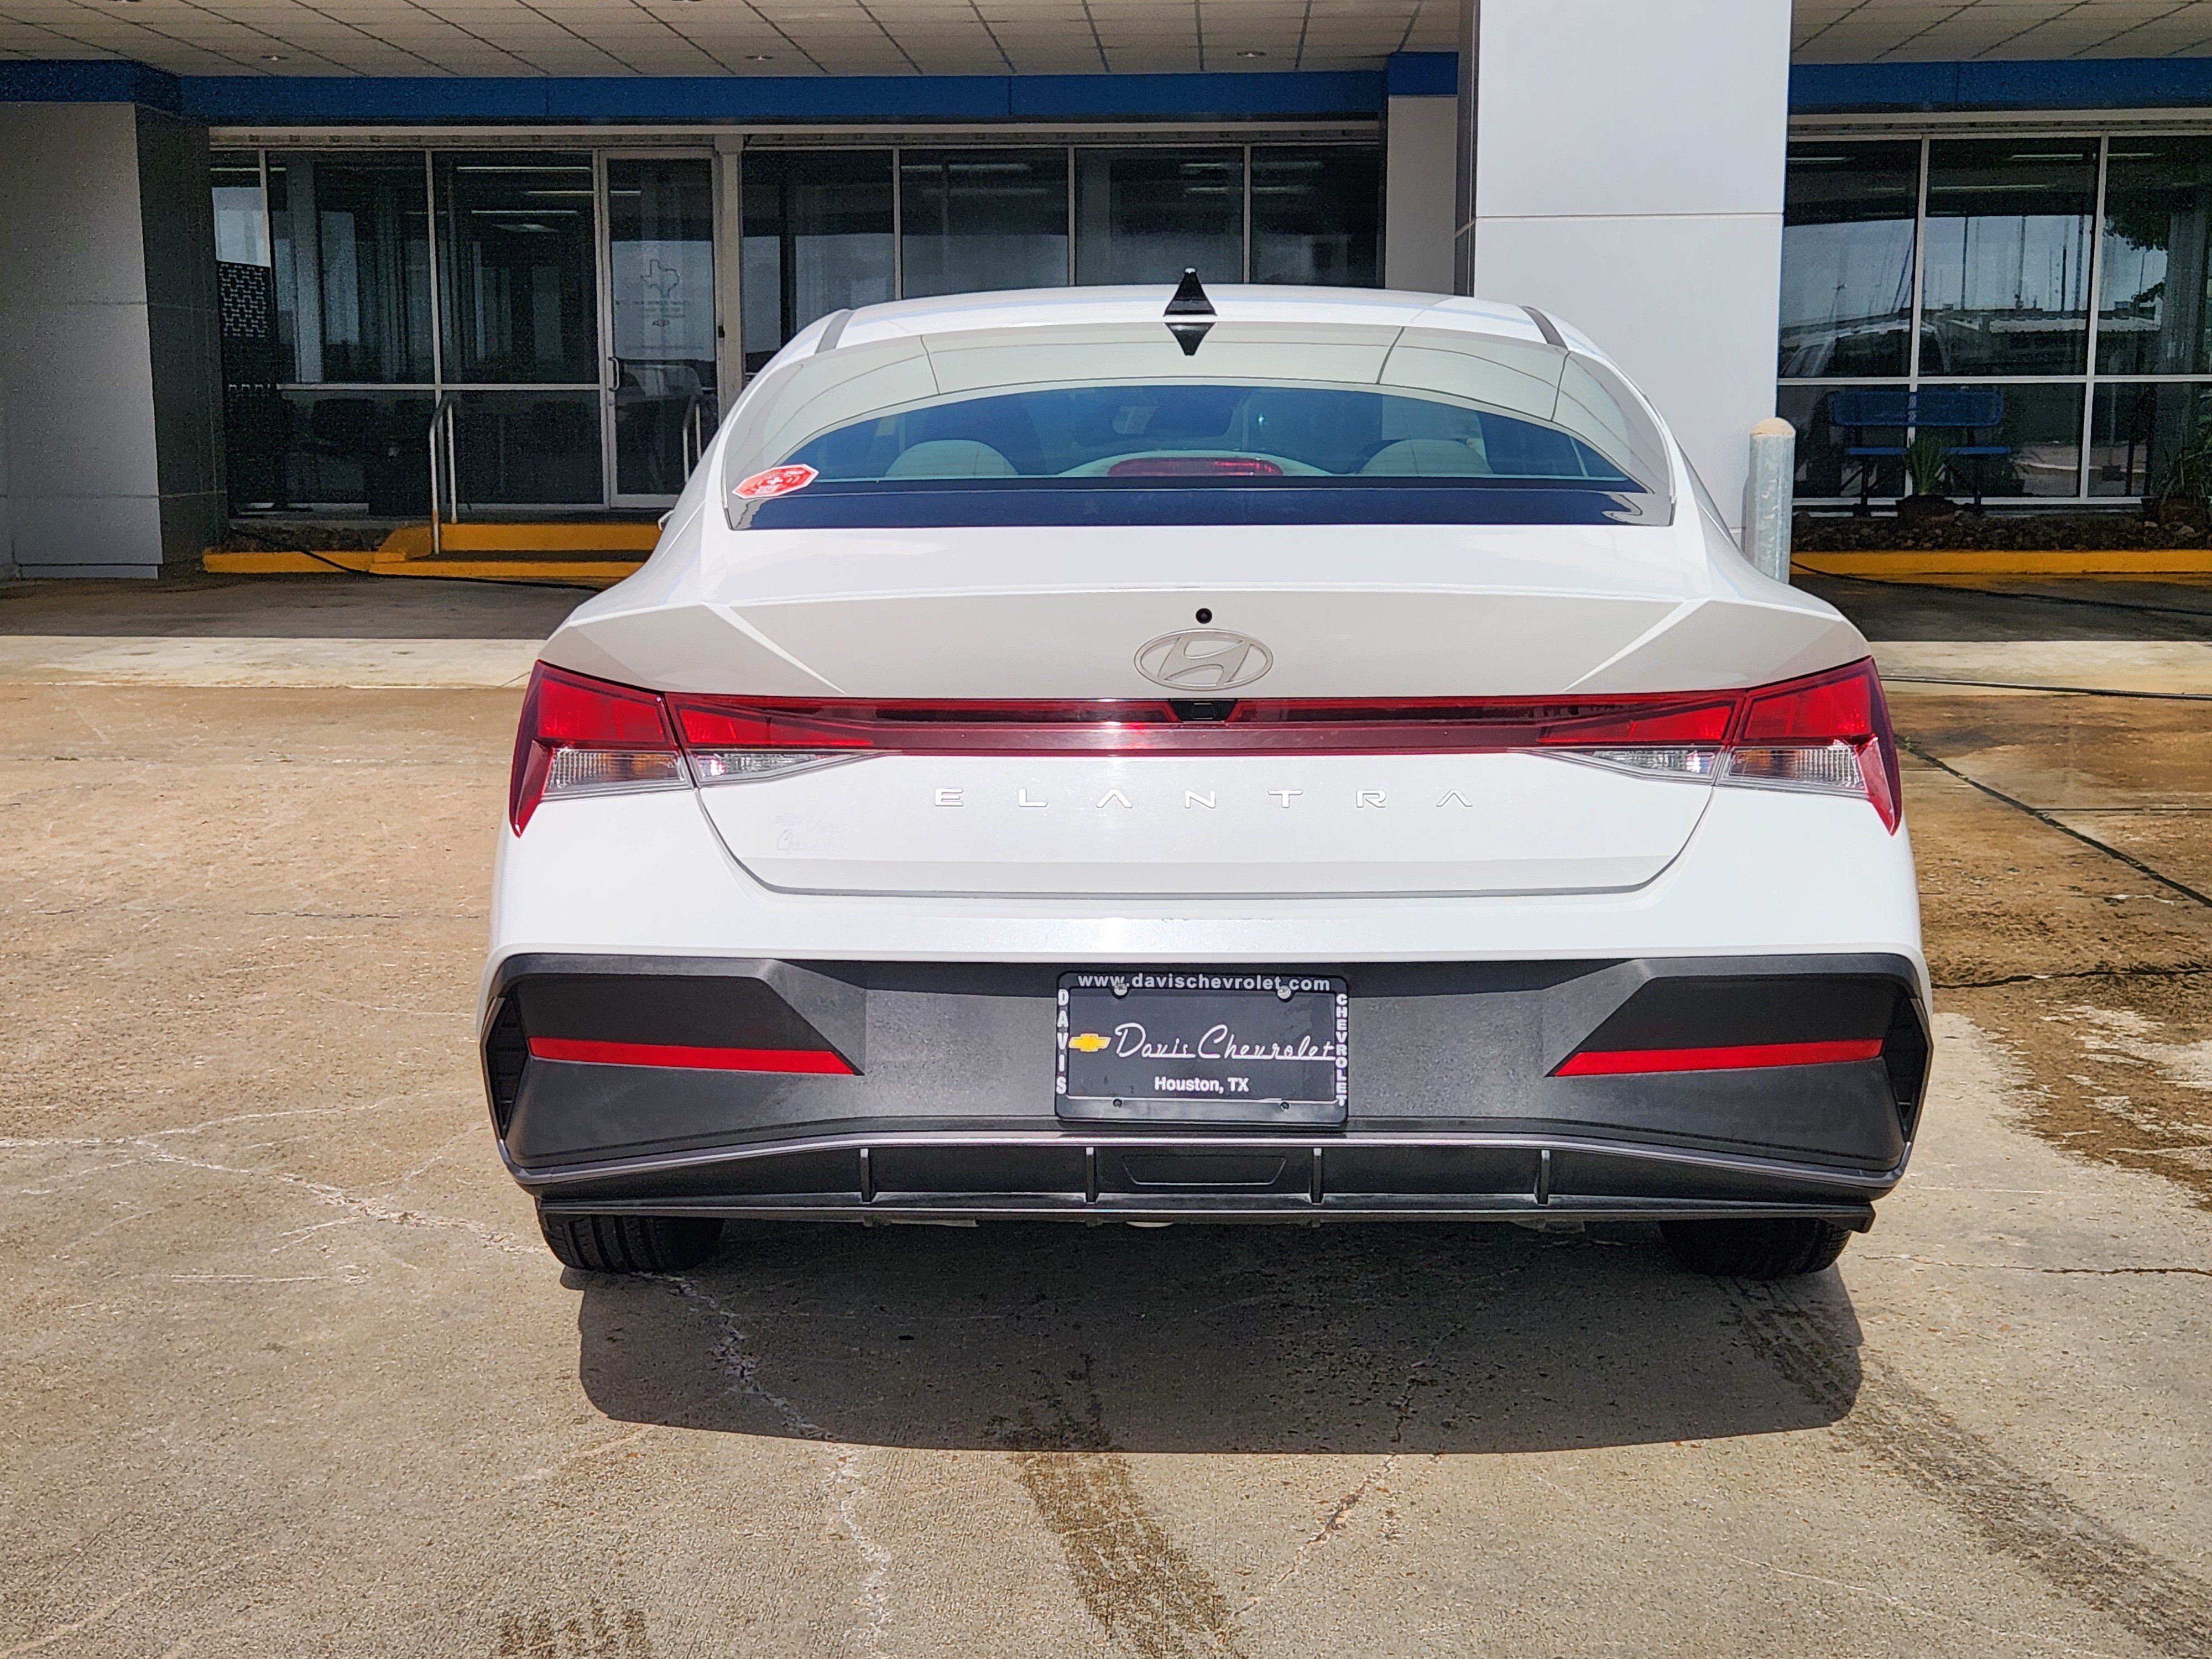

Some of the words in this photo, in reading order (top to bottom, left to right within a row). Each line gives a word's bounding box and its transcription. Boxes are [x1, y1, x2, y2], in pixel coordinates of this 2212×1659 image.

[935, 789, 1473, 809] ELANTRA
[1077, 973, 1331, 992] www.davischevroletcom
[1056, 988, 1069, 1094] DAVIS
[1114, 1022, 1197, 1058] Davis
[1198, 1024, 1336, 1061] Chevrolet
[1335, 993, 1349, 1107] CHEVROLET
[1154, 1076, 1224, 1094] Houston,
[1227, 1077, 1250, 1093] TX
